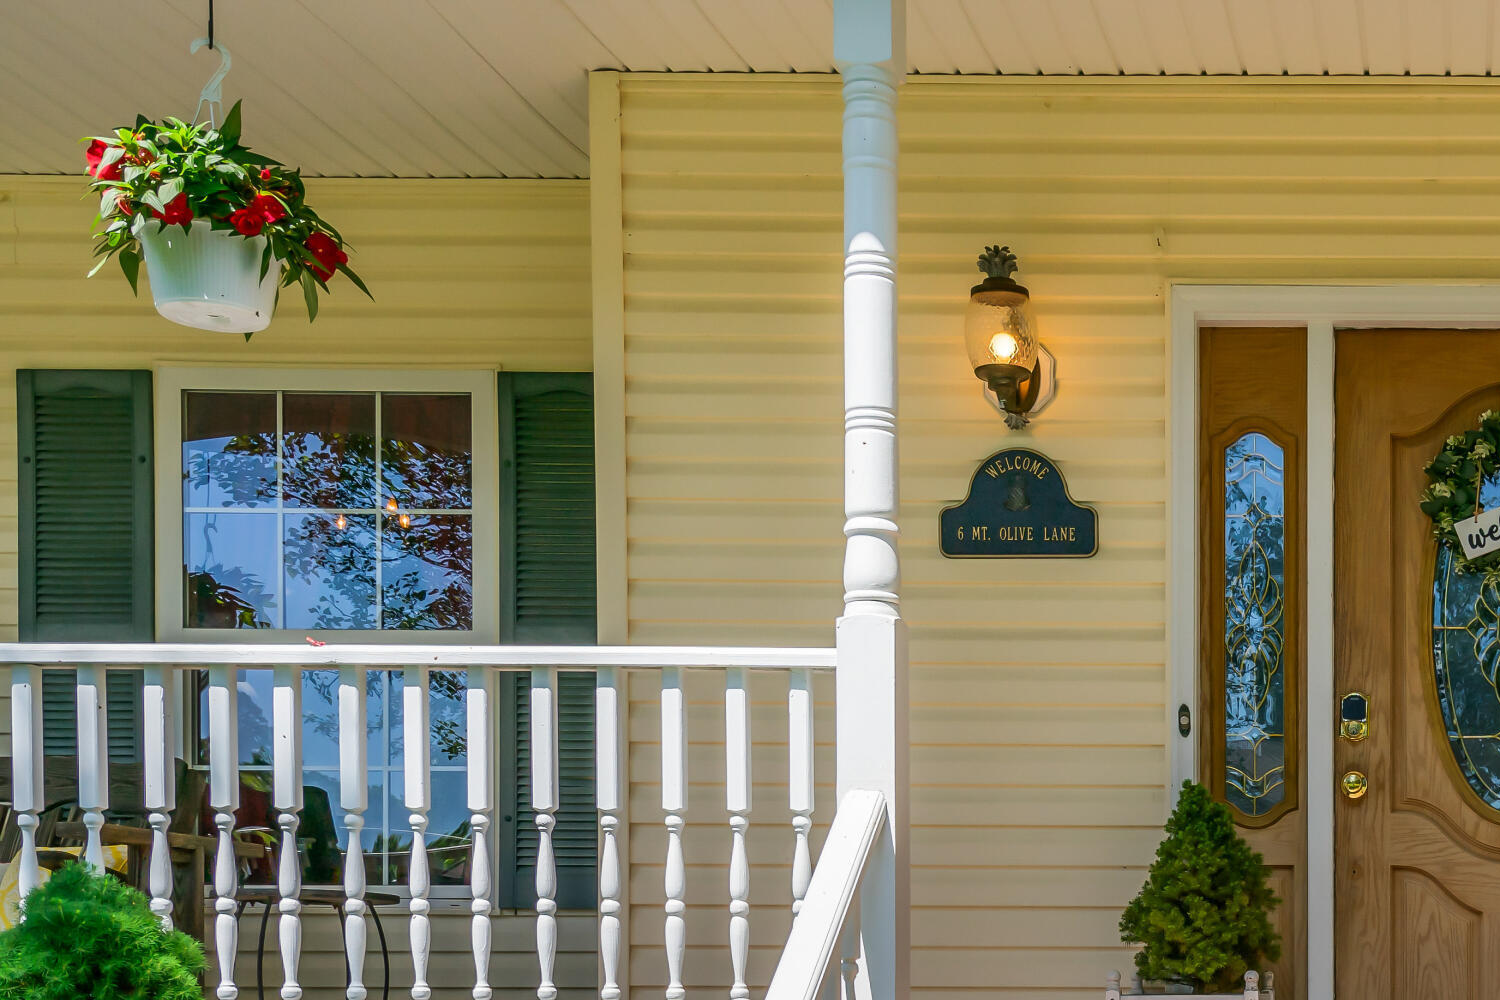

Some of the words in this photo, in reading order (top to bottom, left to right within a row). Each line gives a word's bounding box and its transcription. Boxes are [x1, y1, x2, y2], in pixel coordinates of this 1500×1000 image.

[985, 456, 1049, 480] WELCOME
[957, 526, 964, 540] 6
[972, 526, 991, 541] MT.
[1000, 526, 1033, 541] OLIVE
[1044, 526, 1076, 542] LANE
